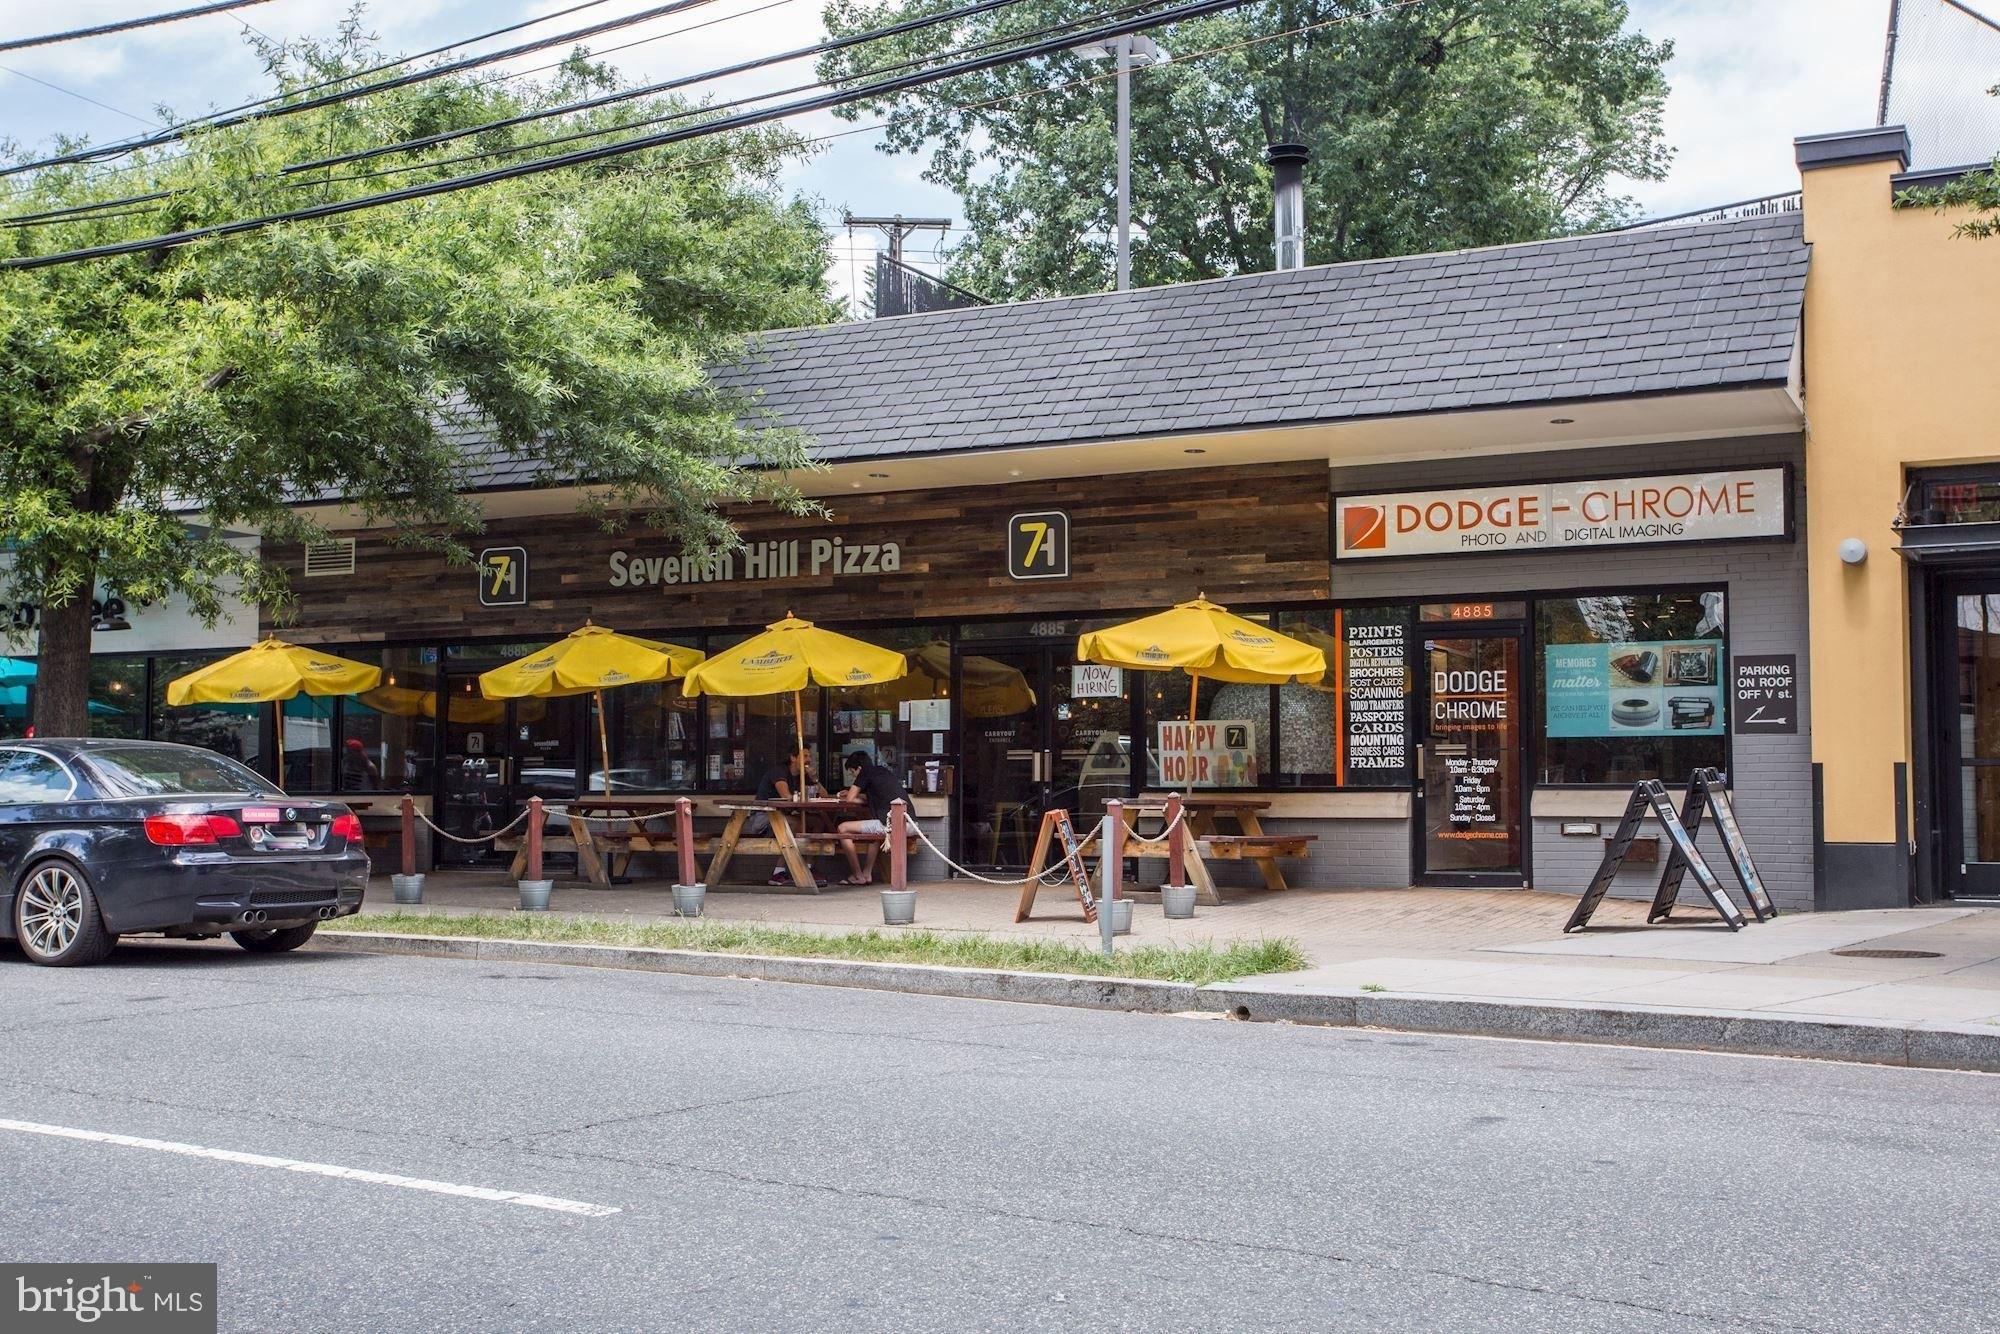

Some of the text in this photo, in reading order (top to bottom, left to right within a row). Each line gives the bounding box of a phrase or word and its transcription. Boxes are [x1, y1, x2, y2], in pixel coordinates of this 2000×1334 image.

[1397, 496, 1539, 533] DODGE
[1582, 482, 1755, 523] CHROME
[1461, 522, 1684, 547] PHOTO AND DIGITAL IMAGING
[745, 539, 799, 579] Hill
[811, 537, 900, 576] Pizza
[1453, 605, 1492, 618] 4885
[1030, 622, 1065, 636] 4885
[1349, 625, 1403, 638] PRINTS
[1349, 638, 1403, 646] ENLARGEMENTS
[1349, 646, 1404, 658] POSTERS
[1350, 658, 1370, 667] DIGITAL
[1555, 657, 1597, 668] MEMORIES
[1082, 666, 1112, 680] NOW
[1350, 667, 1404, 678] BROCHURES
[1739, 665, 1790, 676] PARKING
[1077, 680, 1118, 694] HIRING
[1350, 678, 1404, 687] POST CARDS
[1434, 670, 1507, 693] DODGE
[1552, 675, 1601, 688] matter
[1737, 677, 1793, 688] ON ROOF
[1350, 686, 1404, 699] SCANNING
[1738, 689, 1793, 700] OFF V st.
[1350, 700, 1404, 711] VIDEO TRANSFERS
[1435, 701, 1507, 719] CHROME
[1350, 711, 1404, 722] PASSPORTS
[1350, 722, 1404, 733] CARDS
[1435, 723, 1461, 732] bringing
[1462, 723, 1486, 731] images
[984, 730, 1016, 738] CARRYOUT
[1350, 734, 1404, 746] MOUNTING
[1350, 746, 1404, 756] BUSINESS CARDS
[1350, 756, 1405, 768] FRAMES
[1445, 759, 1468, 767] Monday
[1471, 758, 1499, 767] Thursday
[1449, 766, 1467, 774] 10am
[1463, 776, 1481, 785] Friday
[1454, 785, 1472, 793] 10am
[1459, 795, 1486, 804] Saturday
[1454, 803, 1472, 811] 10am
[1476, 803, 1490, 812] 4pm
[1449, 813, 1471, 823] Sunday
[1475, 813, 1496, 822] Closed
[1437, 831, 1509, 840] www.dodgechrome.com
